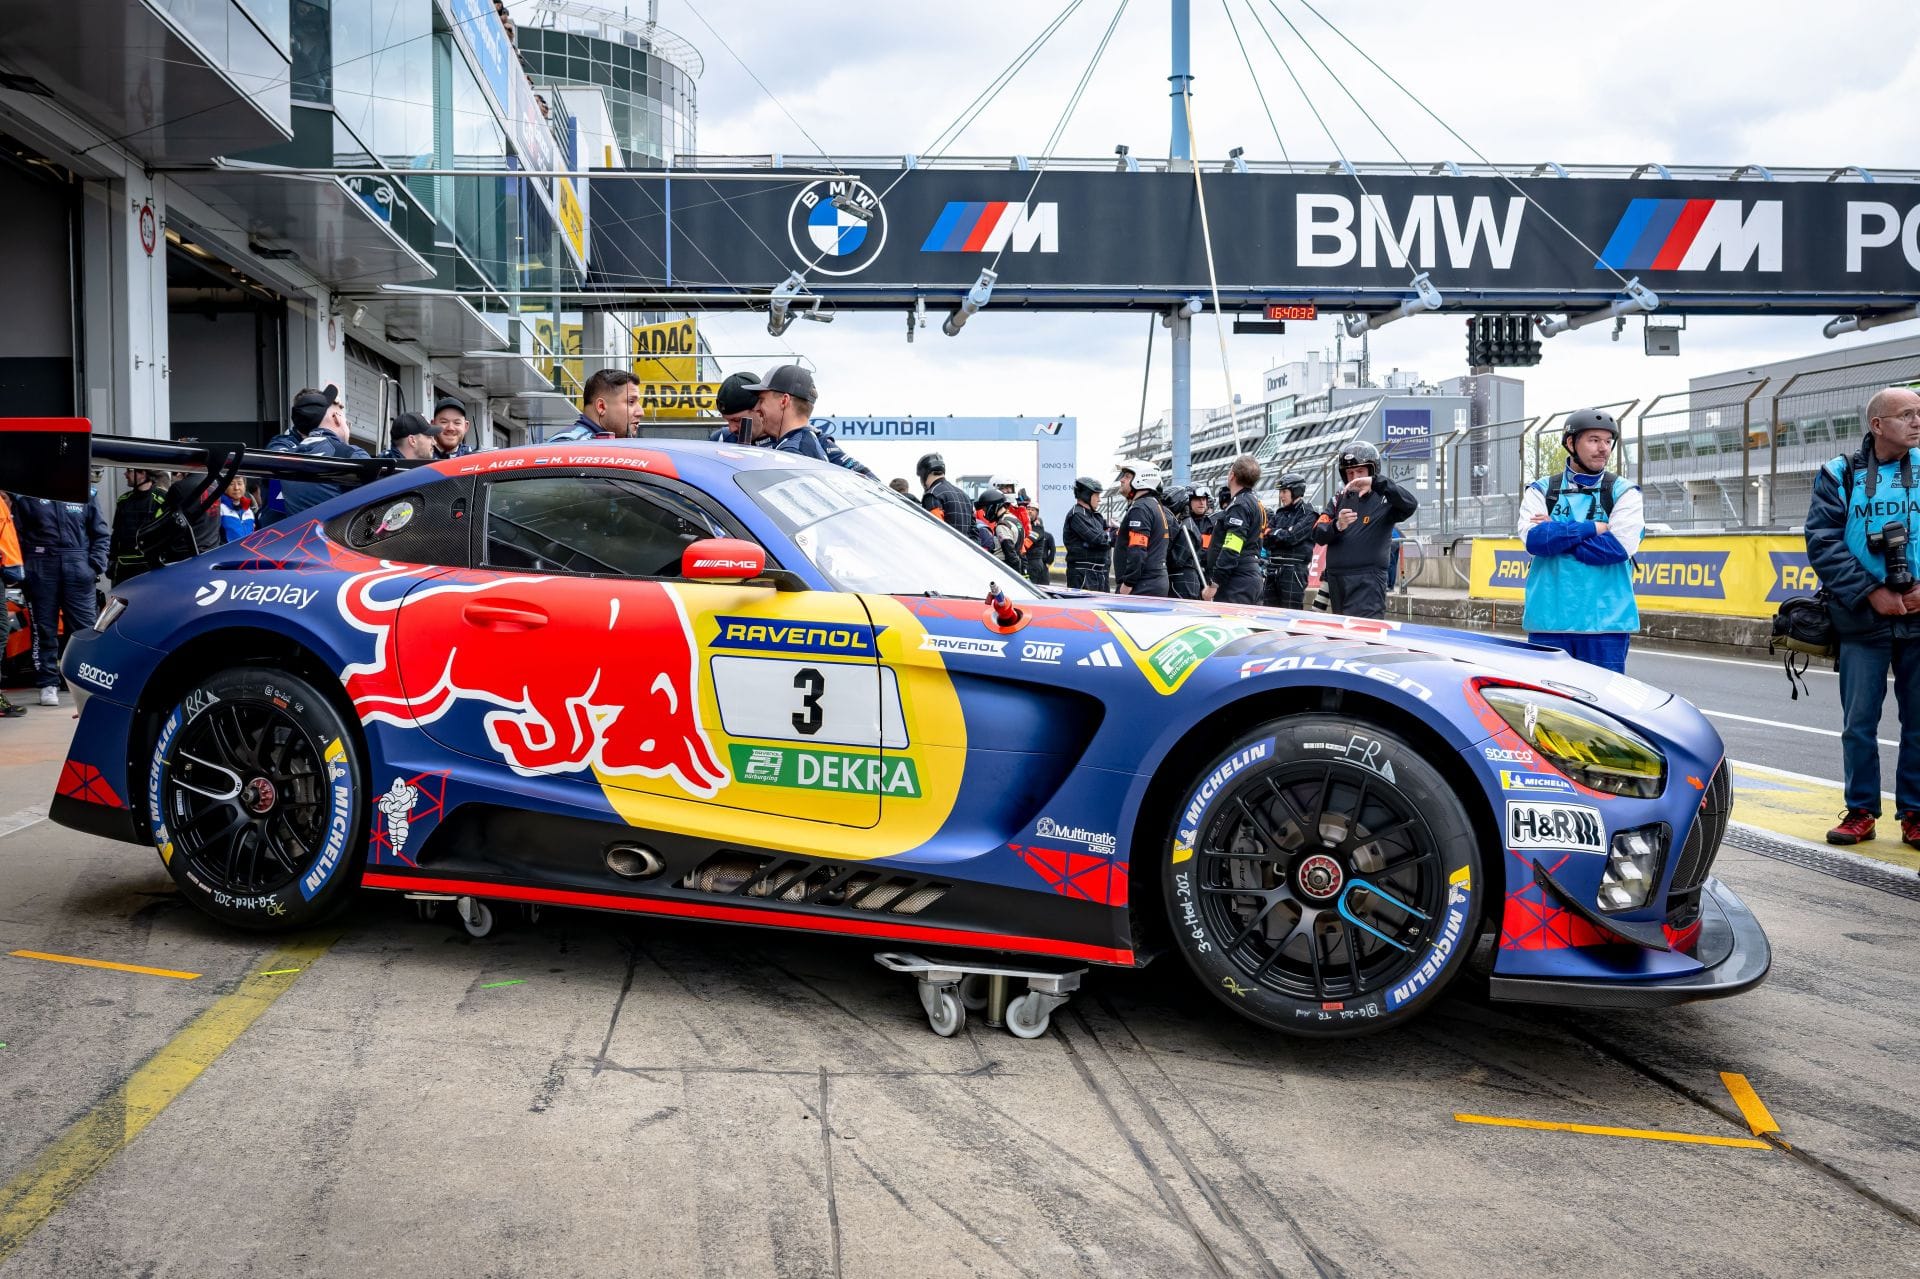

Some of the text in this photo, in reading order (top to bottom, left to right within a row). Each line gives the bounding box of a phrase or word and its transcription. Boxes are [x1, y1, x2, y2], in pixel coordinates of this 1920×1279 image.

[802, 181, 874, 210] BMW
[1296, 193, 1526, 270] BMW
[1271, 307, 1315, 319] 16:40:32
[636, 323, 693, 363] ADAC
[642, 384, 712, 409] ADAC
[842, 421, 935, 435] HYUNDAI
[1387, 425, 1429, 436] Dorint
[488, 458, 525, 469] AUER
[550, 456, 564, 465] M.
[568, 455, 650, 469] VERSTAPPEN
[1855, 500, 1920, 519] MEDIA
[713, 559, 757, 569] AMG
[1498, 560, 1528, 579] RAV
[1633, 562, 1716, 587] AVENOL
[1782, 565, 1818, 590] RA
[230, 581, 320, 610] viaplay
[726, 624, 868, 649] RAVENOL
[927, 637, 999, 654] RAVENOL
[1022, 643, 1064, 660] OMP
[79, 662, 114, 687] sparco
[1236, 656, 1433, 701] FALKEN
[791, 667, 825, 736] 3
[1345, 734, 1381, 771] FR
[1485, 748, 1532, 761] sparco
[150, 713, 178, 822] MICHELIN
[797, 753, 915, 794] DEKRA
[1185, 743, 1266, 827] MICHELIN
[1525, 778, 1570, 788] MICHELIN
[1055, 824, 1117, 846] Multimatic
[1512, 807, 1576, 843] H&R
[304, 784, 349, 893] MICHELIN
[1394, 909, 1463, 1004] MICHELIN
